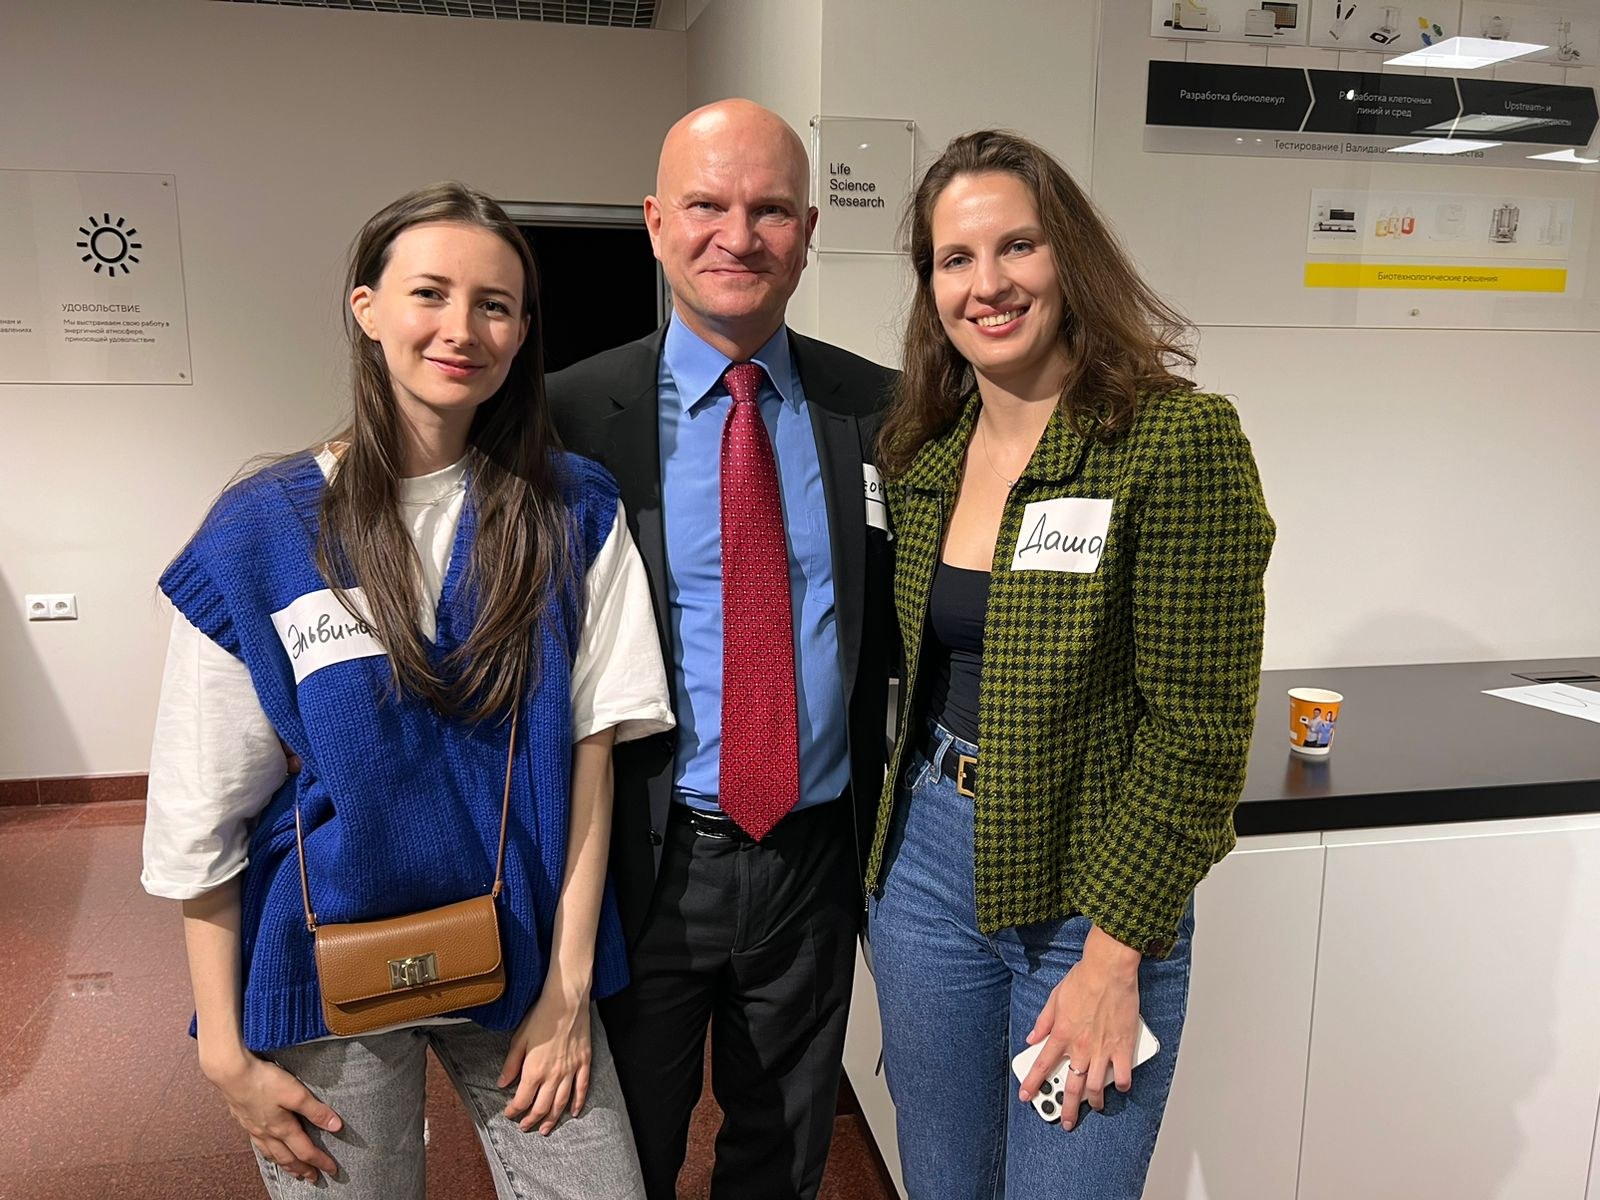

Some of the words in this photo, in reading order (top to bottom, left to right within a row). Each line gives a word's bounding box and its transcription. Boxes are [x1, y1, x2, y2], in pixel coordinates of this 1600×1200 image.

[1179, 89, 1231, 102] Разработка
[1232, 92, 1285, 106] биомолекул
[1339, 90, 1387, 103] Рработка
[1388, 96, 1433, 105] клеточных
[1356, 106, 1384, 116] линий
[1392, 109, 1413, 118] сред
[1504, 101, 1545, 111] Upstream-
[1274, 139, 1339, 152] Тестирование
[830, 162, 851, 175] Life
[830, 178, 876, 192] Science
[830, 194, 885, 208] Research
[1377, 271, 1462, 282] Биотехнологические
[1462, 275, 1499, 283] решения
[61, 303, 141, 313] УДОВОЛЬСТВИЕ
[141, 320, 164, 328] работу
[1018, 512, 1103, 559] Даша
